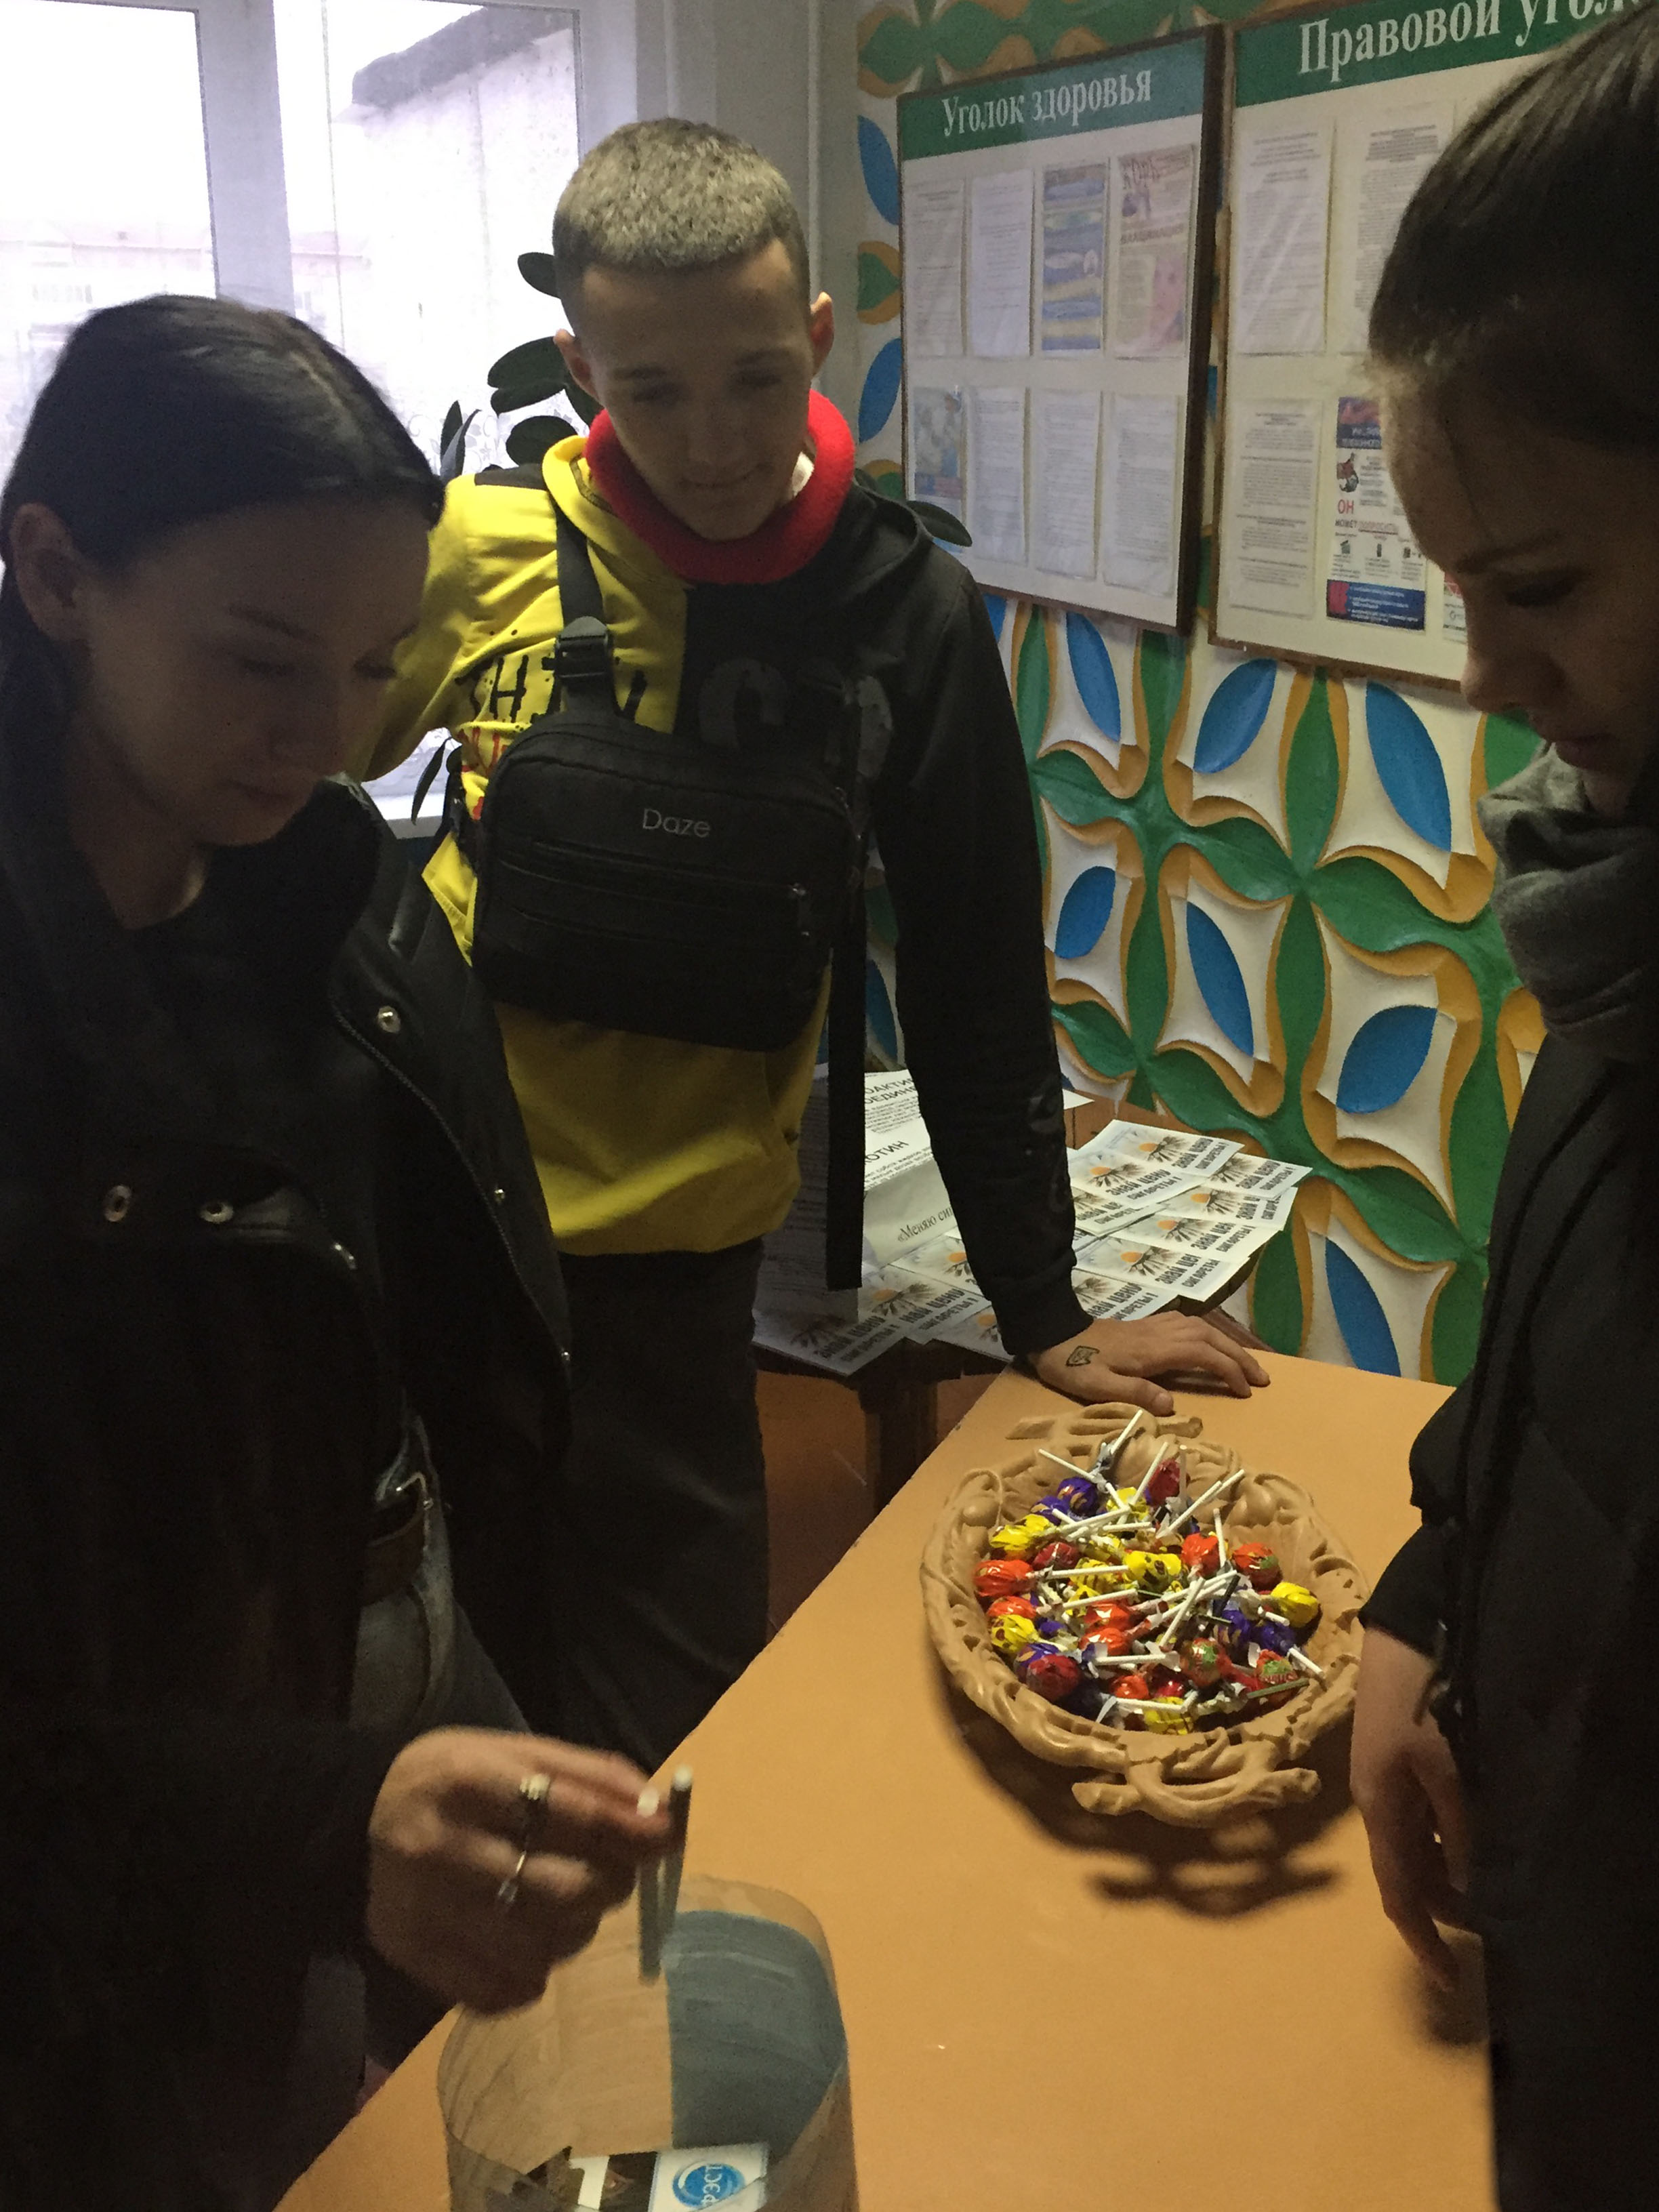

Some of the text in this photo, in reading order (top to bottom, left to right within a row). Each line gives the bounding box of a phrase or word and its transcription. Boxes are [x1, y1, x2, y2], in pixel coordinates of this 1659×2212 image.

[941, 70, 1151, 136] Уголок здоровья
[642, 808, 710, 838] Daze
